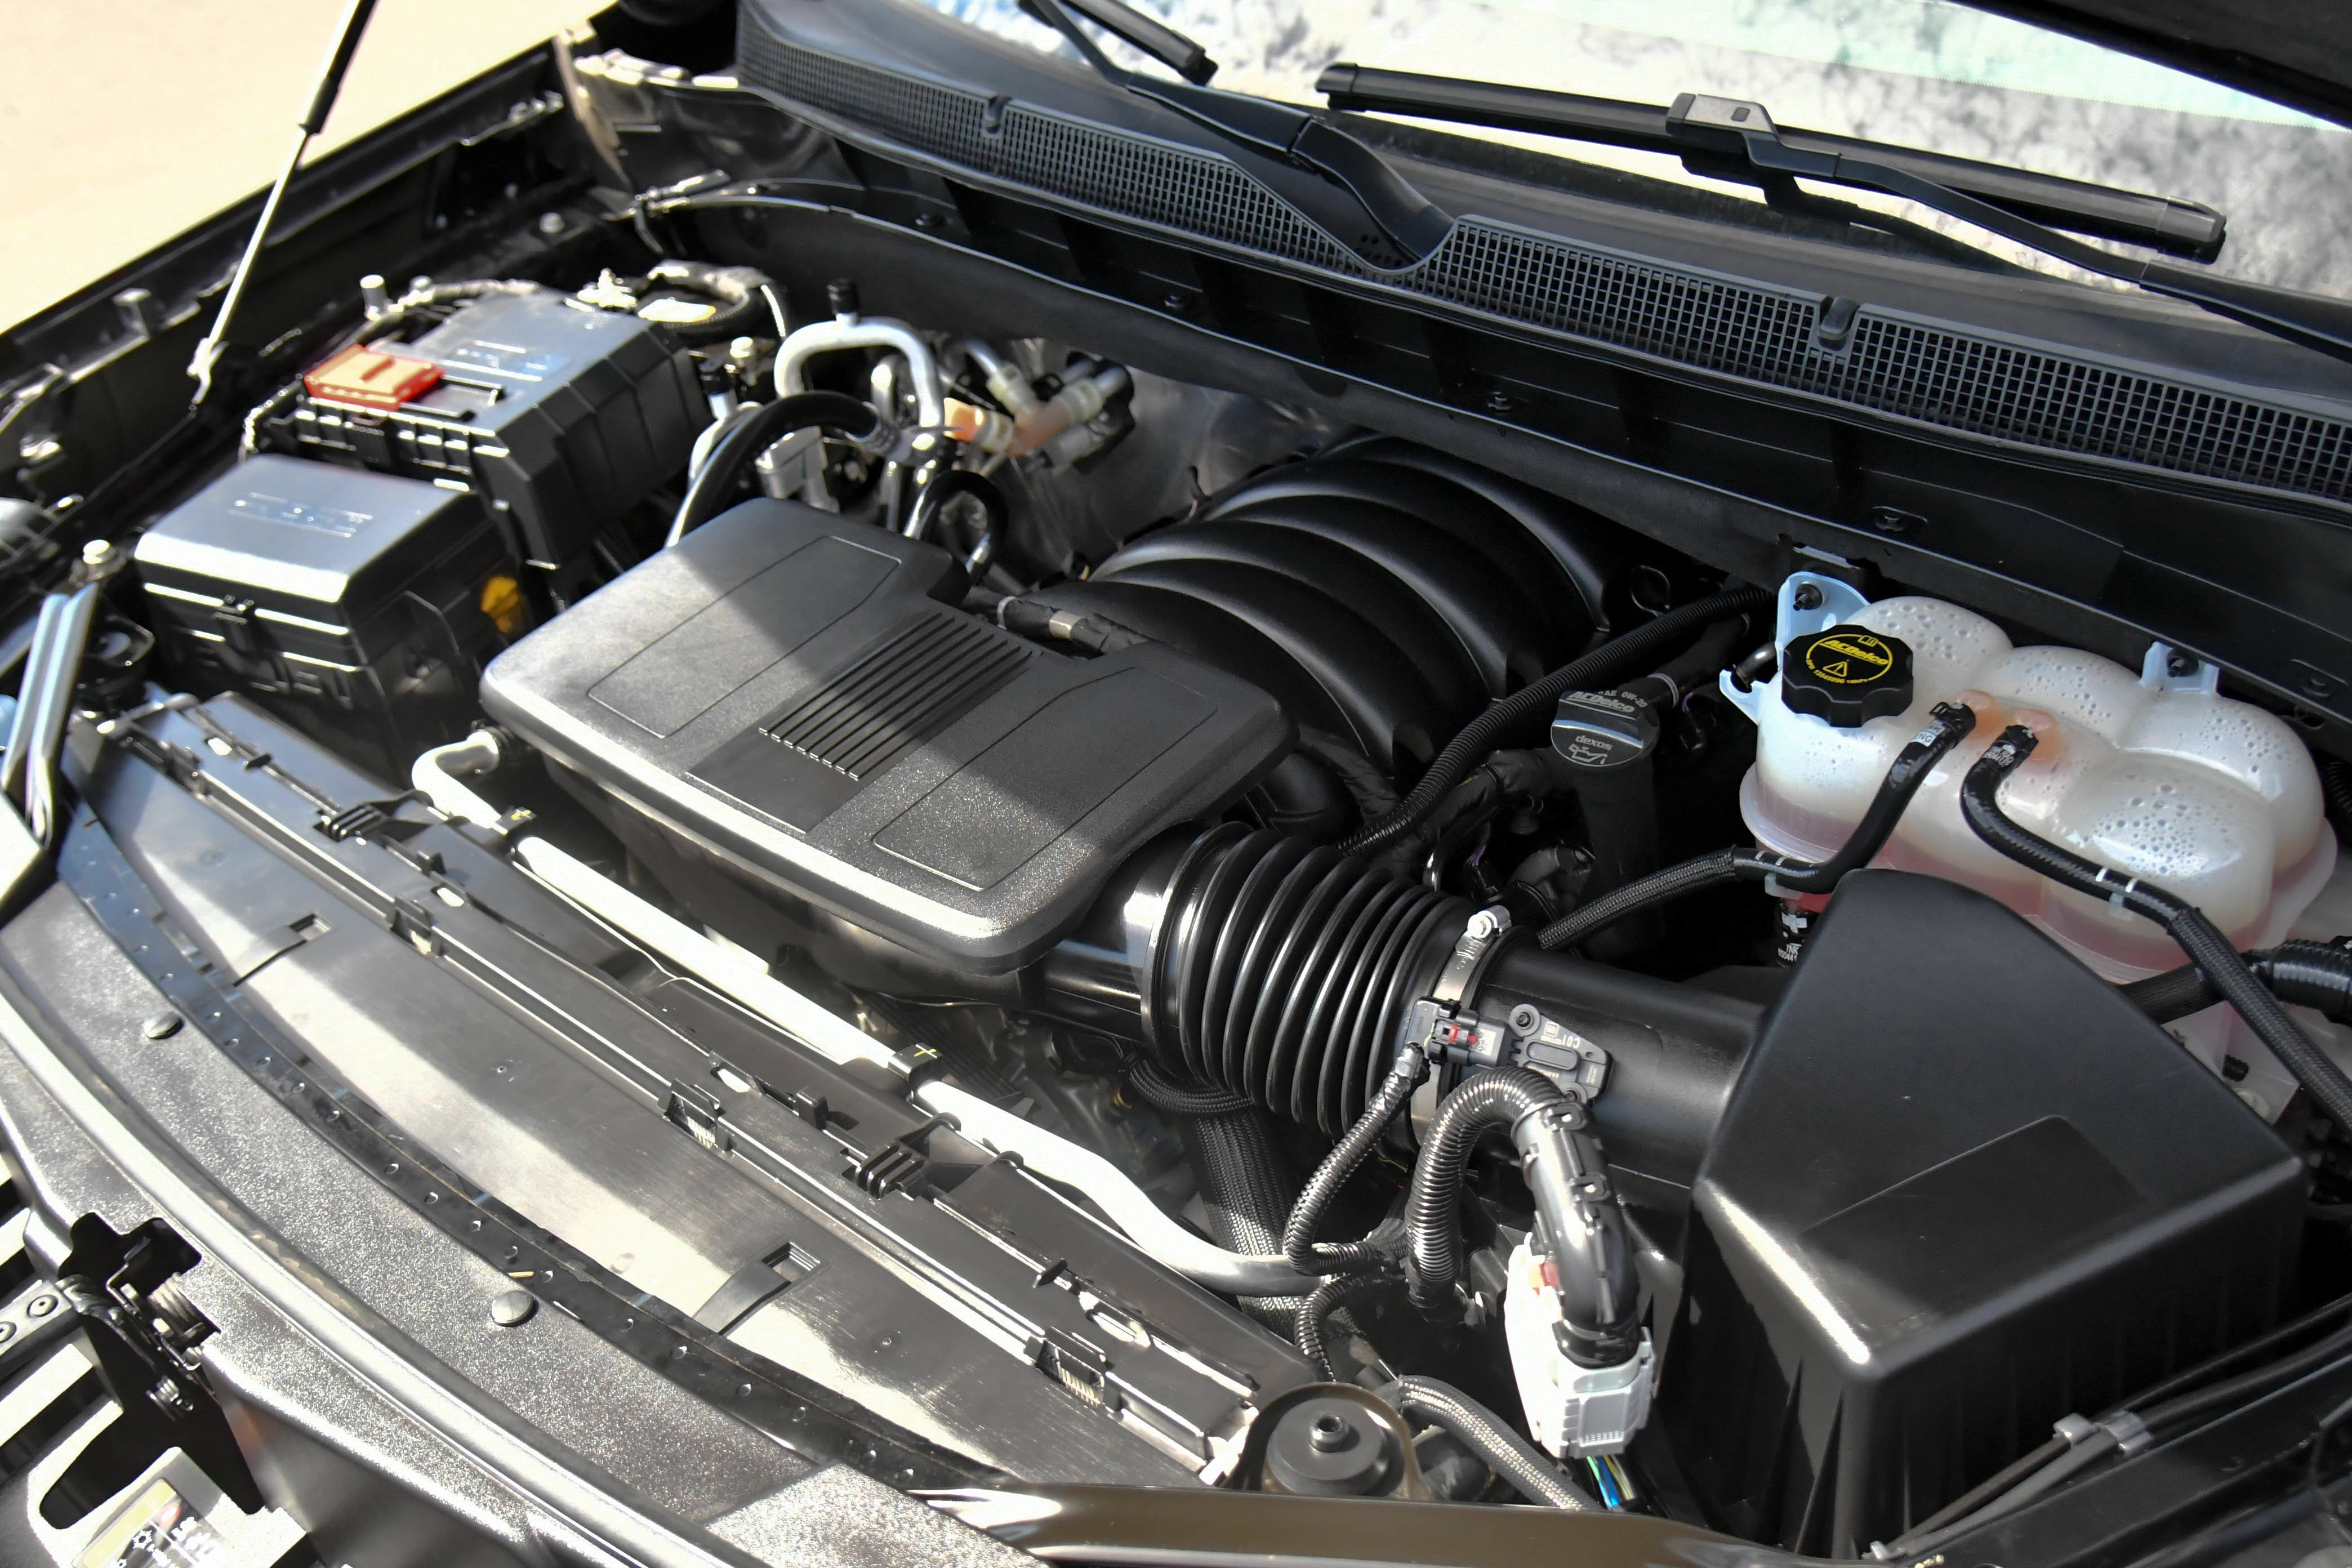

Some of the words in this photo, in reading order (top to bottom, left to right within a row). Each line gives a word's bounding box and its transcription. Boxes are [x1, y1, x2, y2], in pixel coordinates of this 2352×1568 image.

[1824, 640, 1888, 665] ACDelco
[1567, 691, 1635, 713] ACDelco
[1621, 691, 1648, 708] 0W-20
[1575, 734, 1613, 751] dexos
